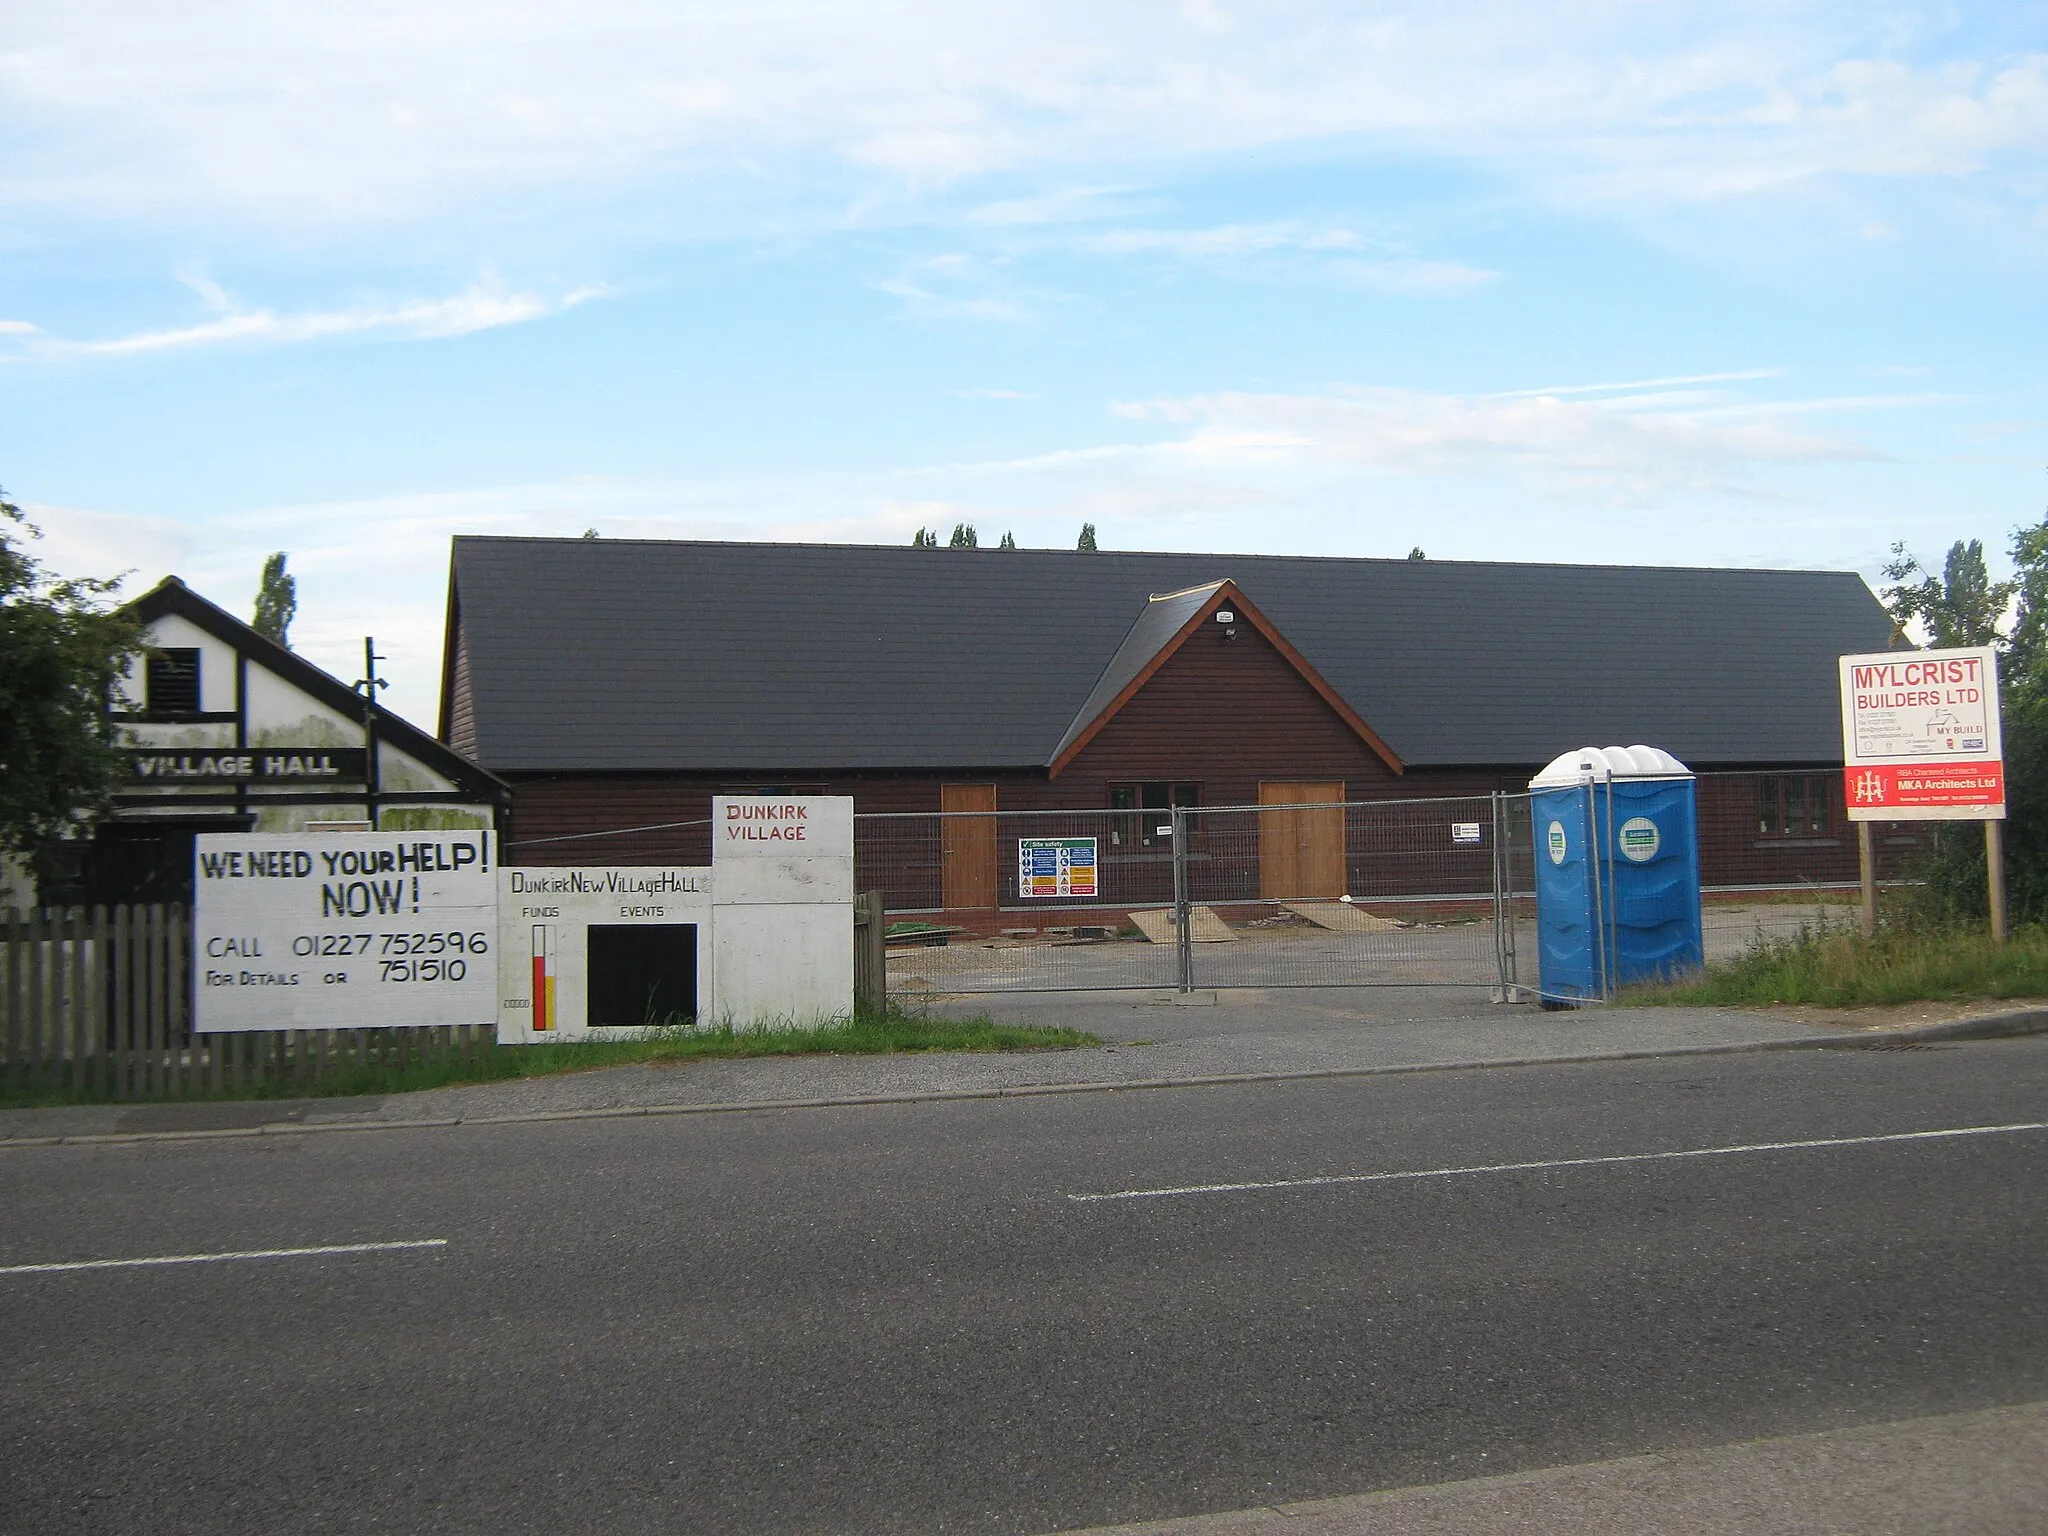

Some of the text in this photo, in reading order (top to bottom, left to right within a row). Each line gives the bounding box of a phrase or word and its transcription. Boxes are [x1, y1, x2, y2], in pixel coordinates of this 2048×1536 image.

[1855, 659, 1979, 689] MYLCRIST
[1857, 688, 1979, 710] BUILDERS LTD
[1936, 725, 1983, 736] MY BUILD
[137, 755, 339, 777] VILLAGE HALL
[1897, 777, 1996, 791] MKA Architects Ltd
[726, 804, 808, 820] DUNKIRK
[726, 825, 806, 841] VILLAGE
[200, 830, 489, 879] WE NEED YOUR HELP!
[661, 871, 700, 893] HALL
[522, 906, 664, 918] FUNDS EVENTS
[206, 931, 488, 958] CALL 01227 752596
[205, 959, 466, 986] FOR DETAILS OR 751510
